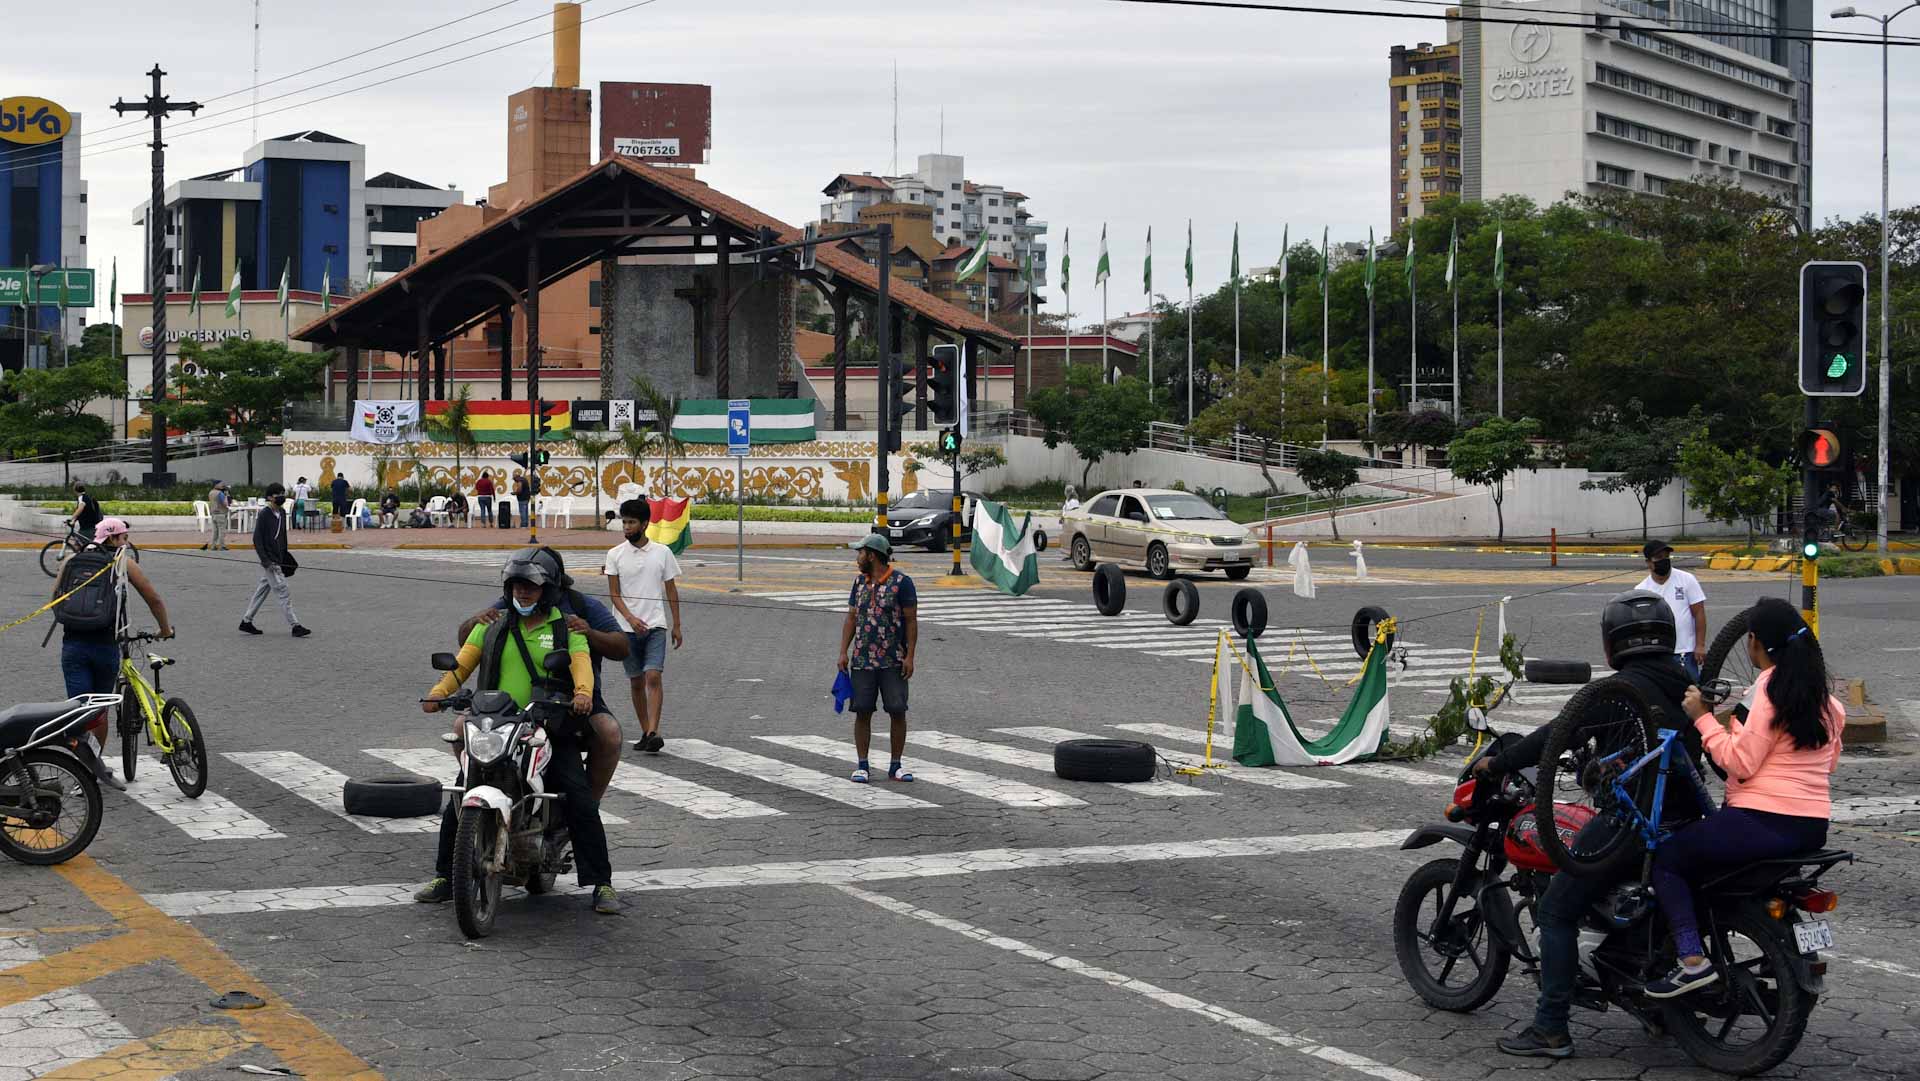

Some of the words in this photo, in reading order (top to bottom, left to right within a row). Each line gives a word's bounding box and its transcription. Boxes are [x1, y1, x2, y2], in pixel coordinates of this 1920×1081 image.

[1497, 65, 1530, 80] Hotel
[1489, 76, 1575, 102] CORTEZ
[0, 105, 61, 135] bisa
[617, 145, 677, 156] 77067526
[165, 330, 214, 342] BURGER
[215, 329, 251, 341] KING
